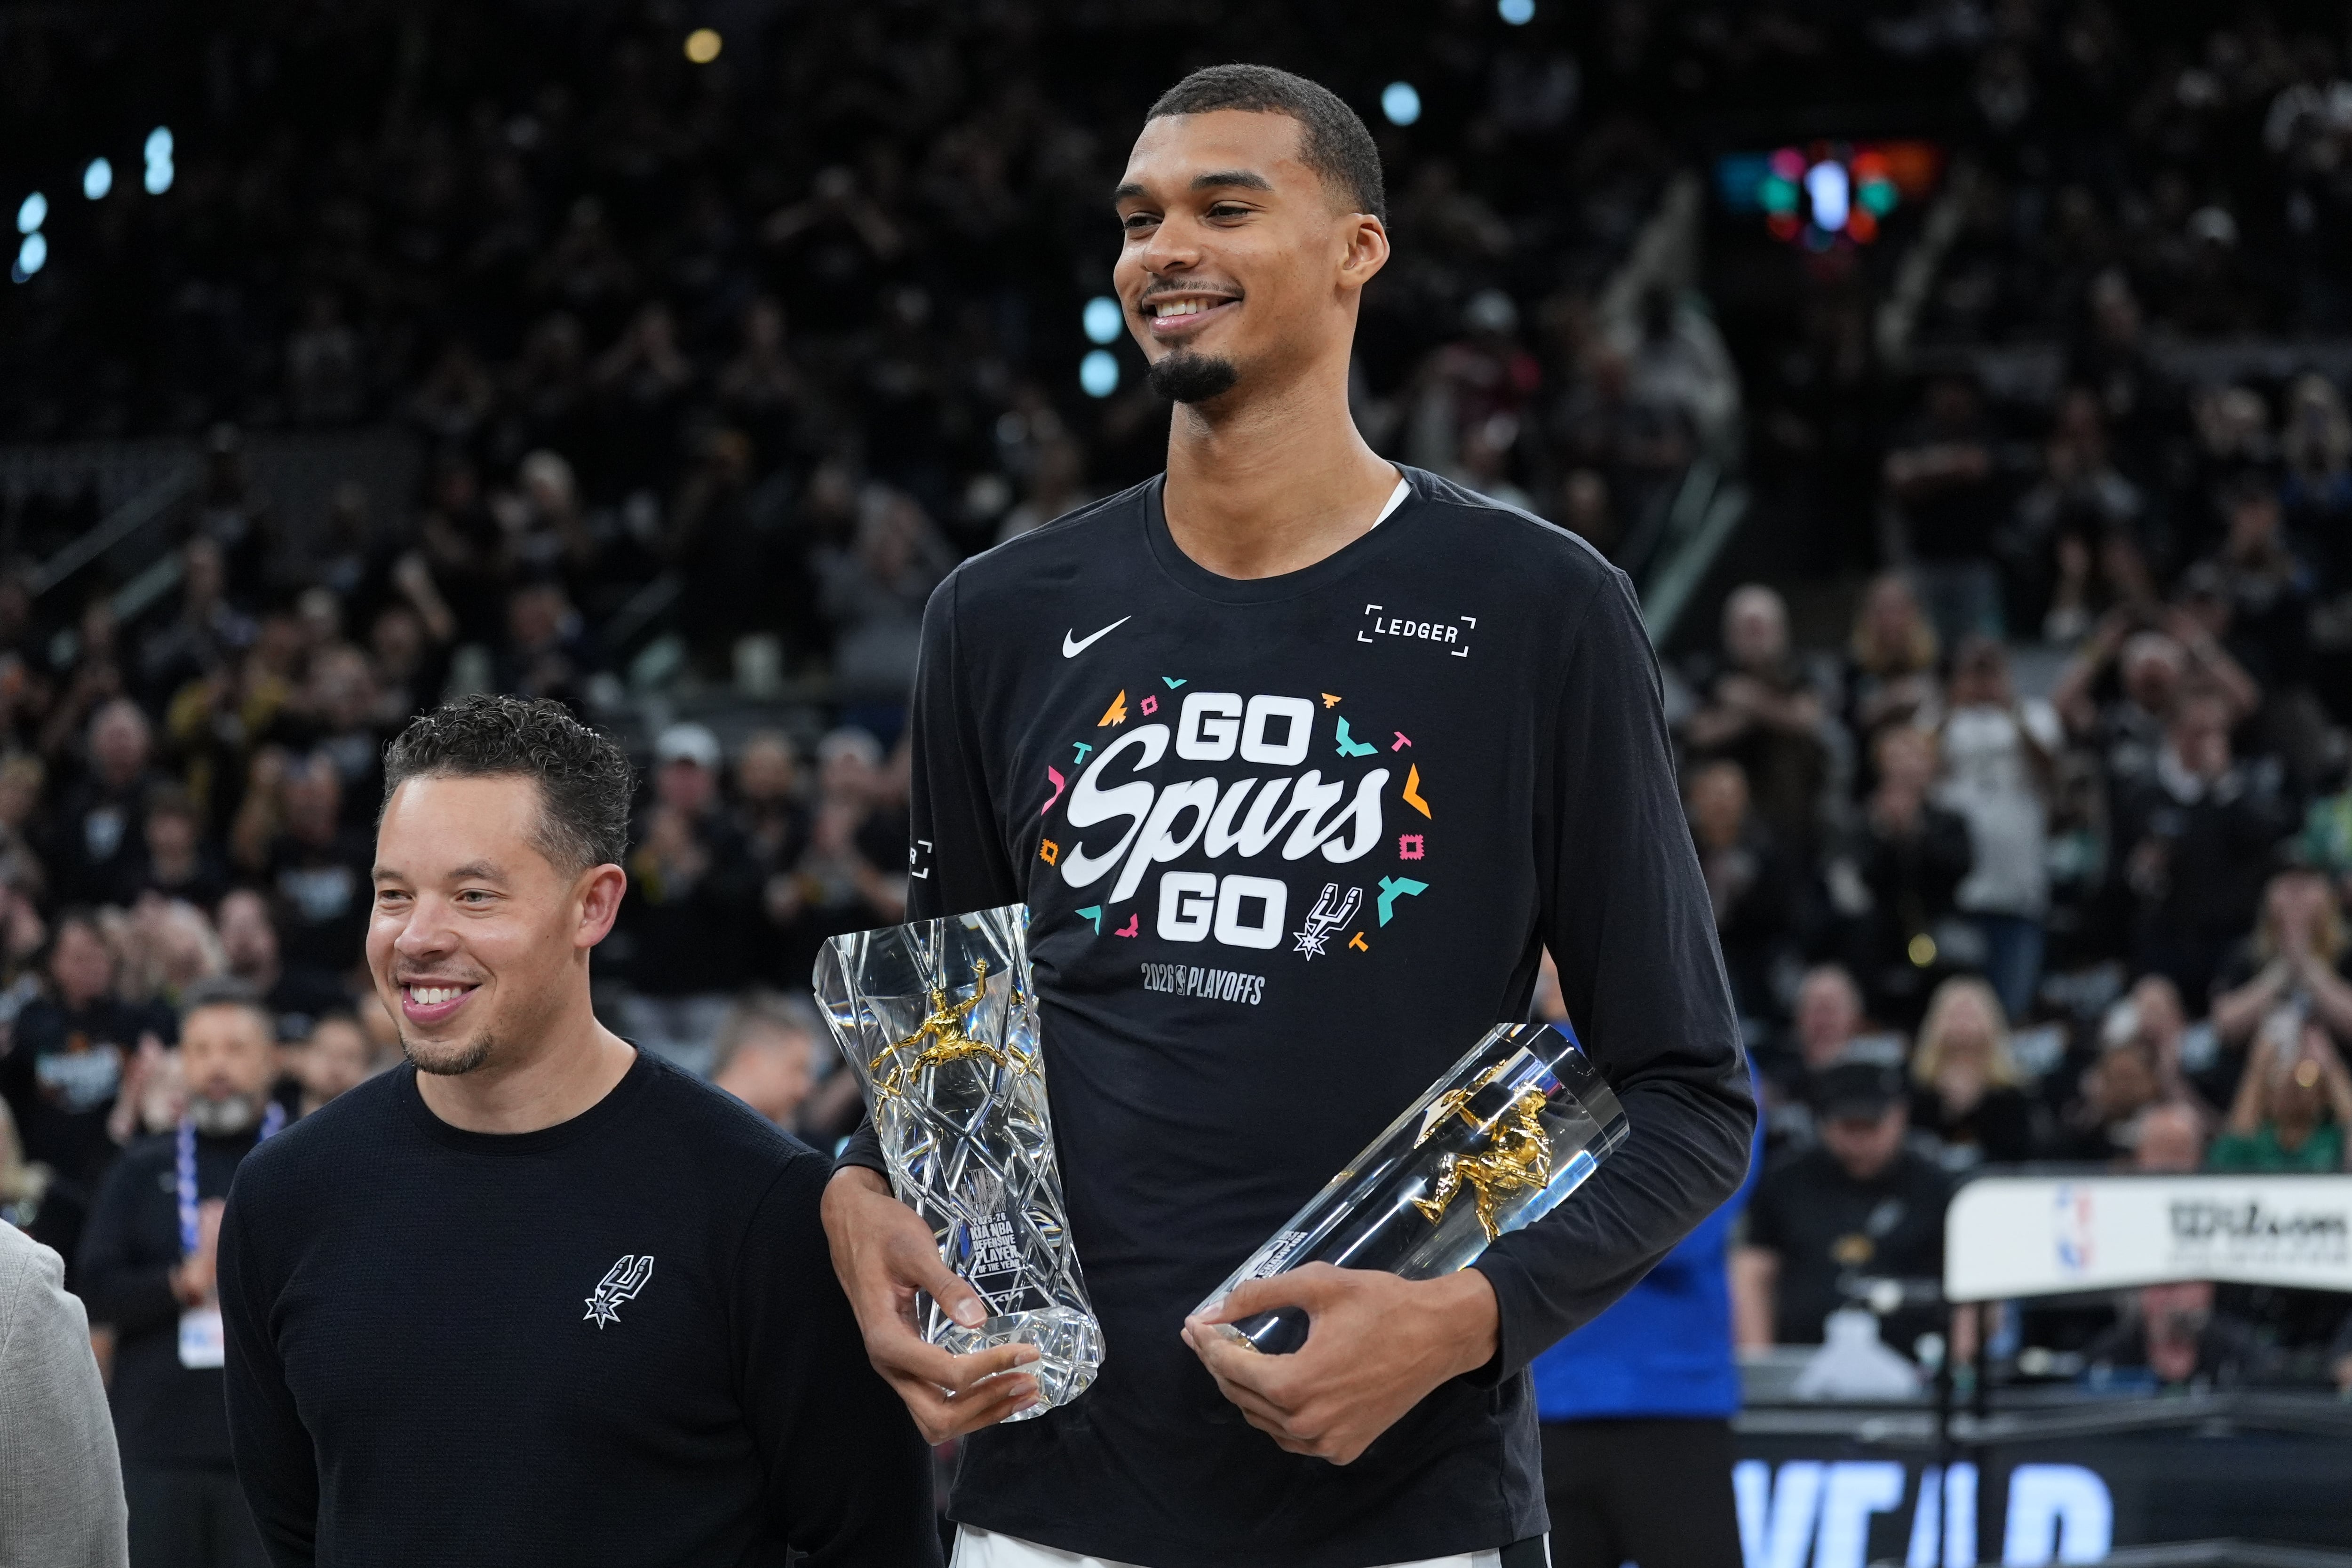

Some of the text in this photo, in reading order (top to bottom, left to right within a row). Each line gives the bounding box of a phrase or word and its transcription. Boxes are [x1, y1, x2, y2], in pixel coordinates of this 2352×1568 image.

[1375, 617, 1458, 643] LEDGER
[1176, 692, 1315, 766] GO
[1060, 723, 1390, 904] Spurs
[1157, 870, 1288, 950] GO
[1141, 963, 1265, 1005] 2026 PLAYOFFS
[970, 1221, 1013, 1241] KIA NBA
[972, 1234, 1016, 1251] DEFENSIVE
[975, 1245, 1018, 1265] PLAYER
[978, 1259, 1020, 1274] OF THE YEAR
